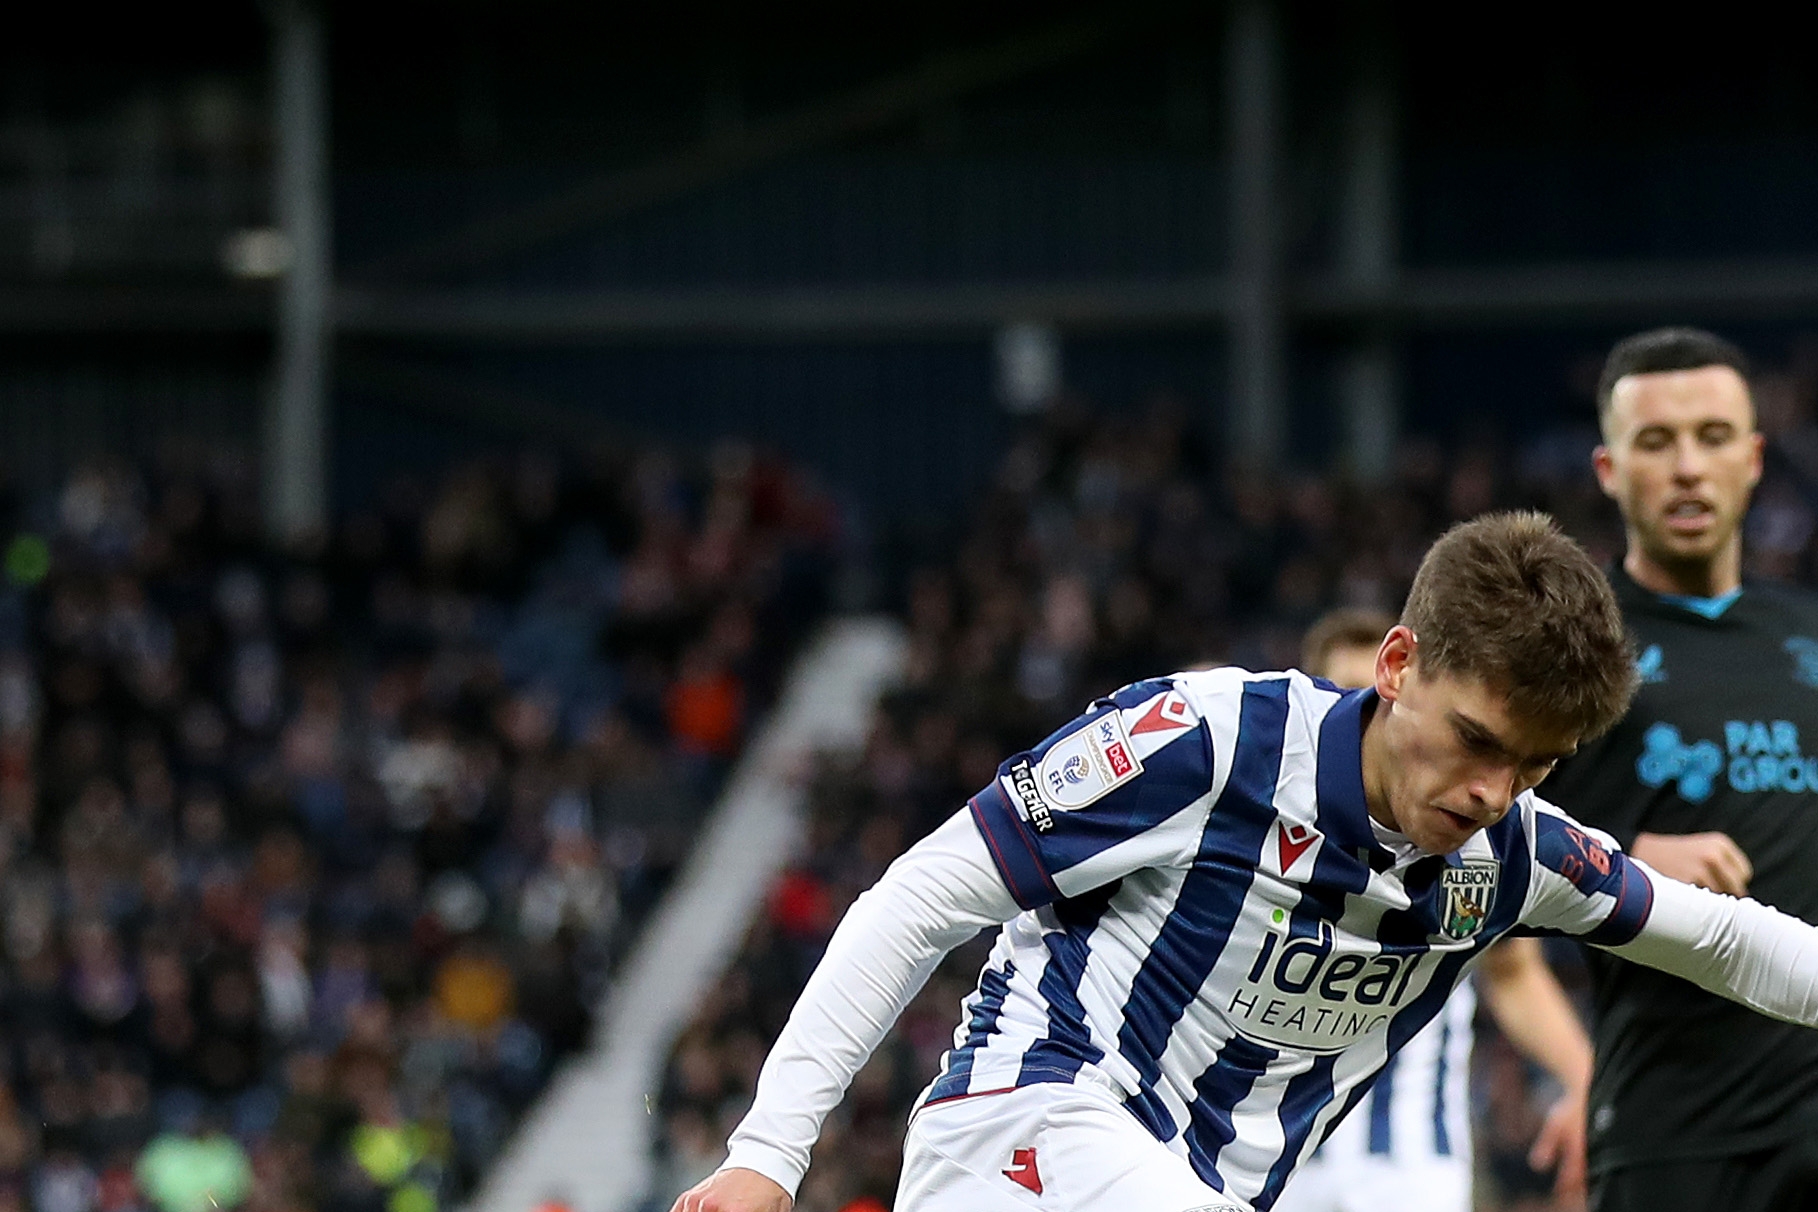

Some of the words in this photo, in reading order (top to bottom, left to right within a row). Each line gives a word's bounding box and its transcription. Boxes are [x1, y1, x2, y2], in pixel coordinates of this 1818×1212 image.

[1100, 721, 1115, 743] sky
[1108, 743, 1130, 773] bet
[1724, 719, 1799, 757] PAR
[1048, 769, 1065, 795] EFL
[1443, 870, 1495, 886] ALBION
[1247, 908, 1421, 1007] ideal
